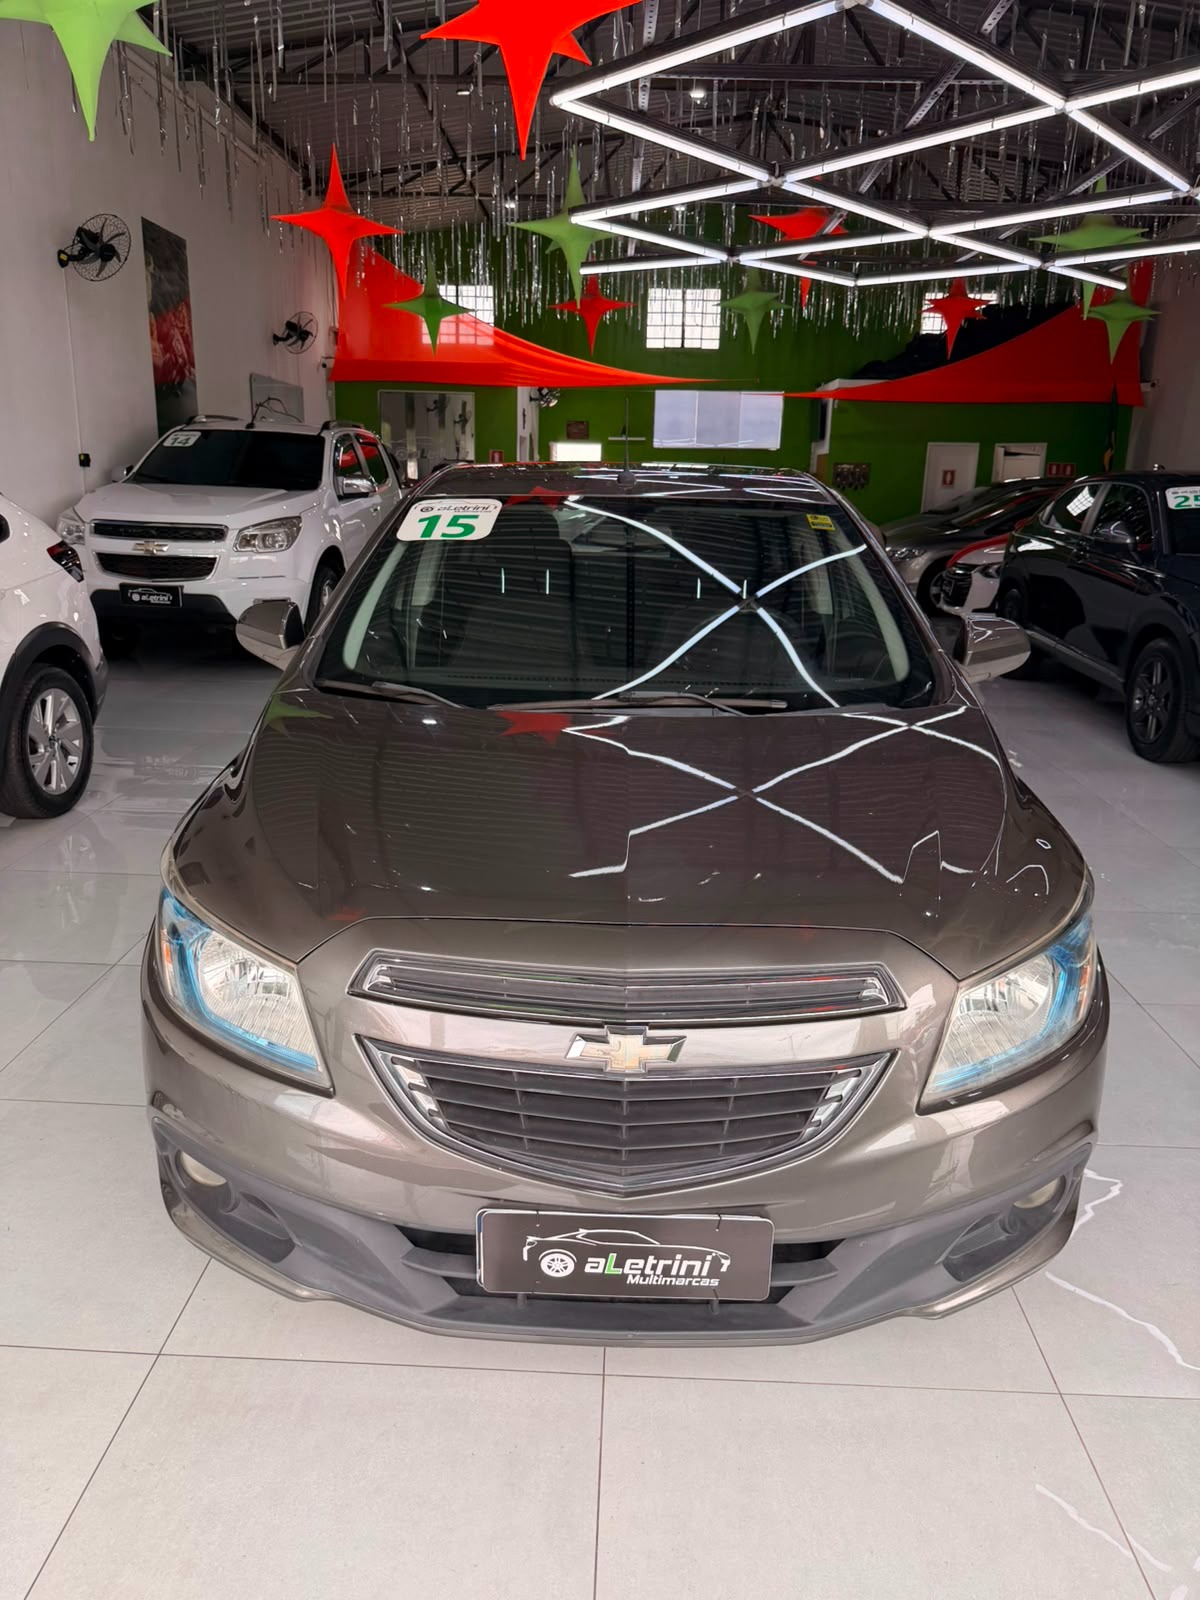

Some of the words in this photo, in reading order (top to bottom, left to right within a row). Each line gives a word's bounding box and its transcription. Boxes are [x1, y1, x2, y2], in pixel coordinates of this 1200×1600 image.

[418, 514, 480, 539] 15
[584, 1253, 714, 1276] aLetrini
[626, 1274, 720, 1286] Multimarcas
